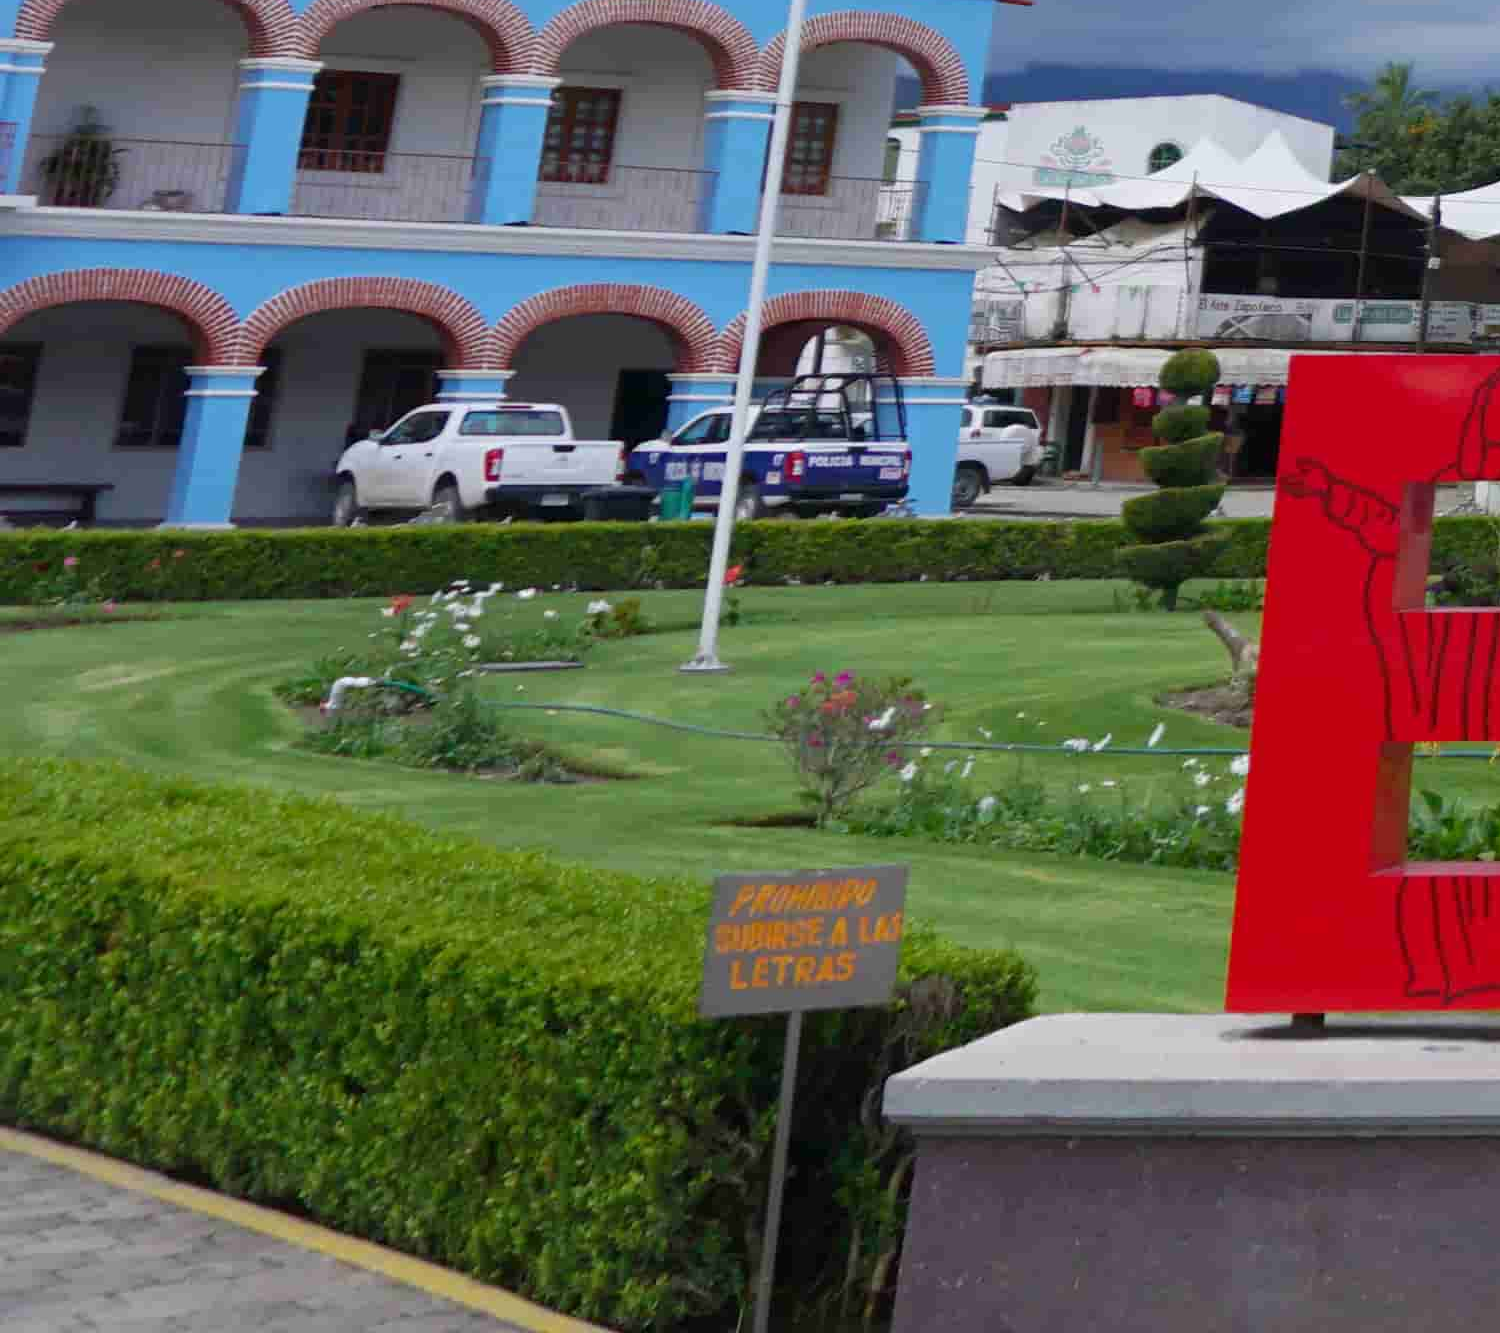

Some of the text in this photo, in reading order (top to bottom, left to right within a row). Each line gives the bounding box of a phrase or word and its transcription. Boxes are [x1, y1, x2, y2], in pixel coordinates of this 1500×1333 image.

[807, 454, 853, 467] POLICIA
[713, 907, 904, 955] SUBIRSE A LAS
[727, 950, 857, 991] LETRAS
